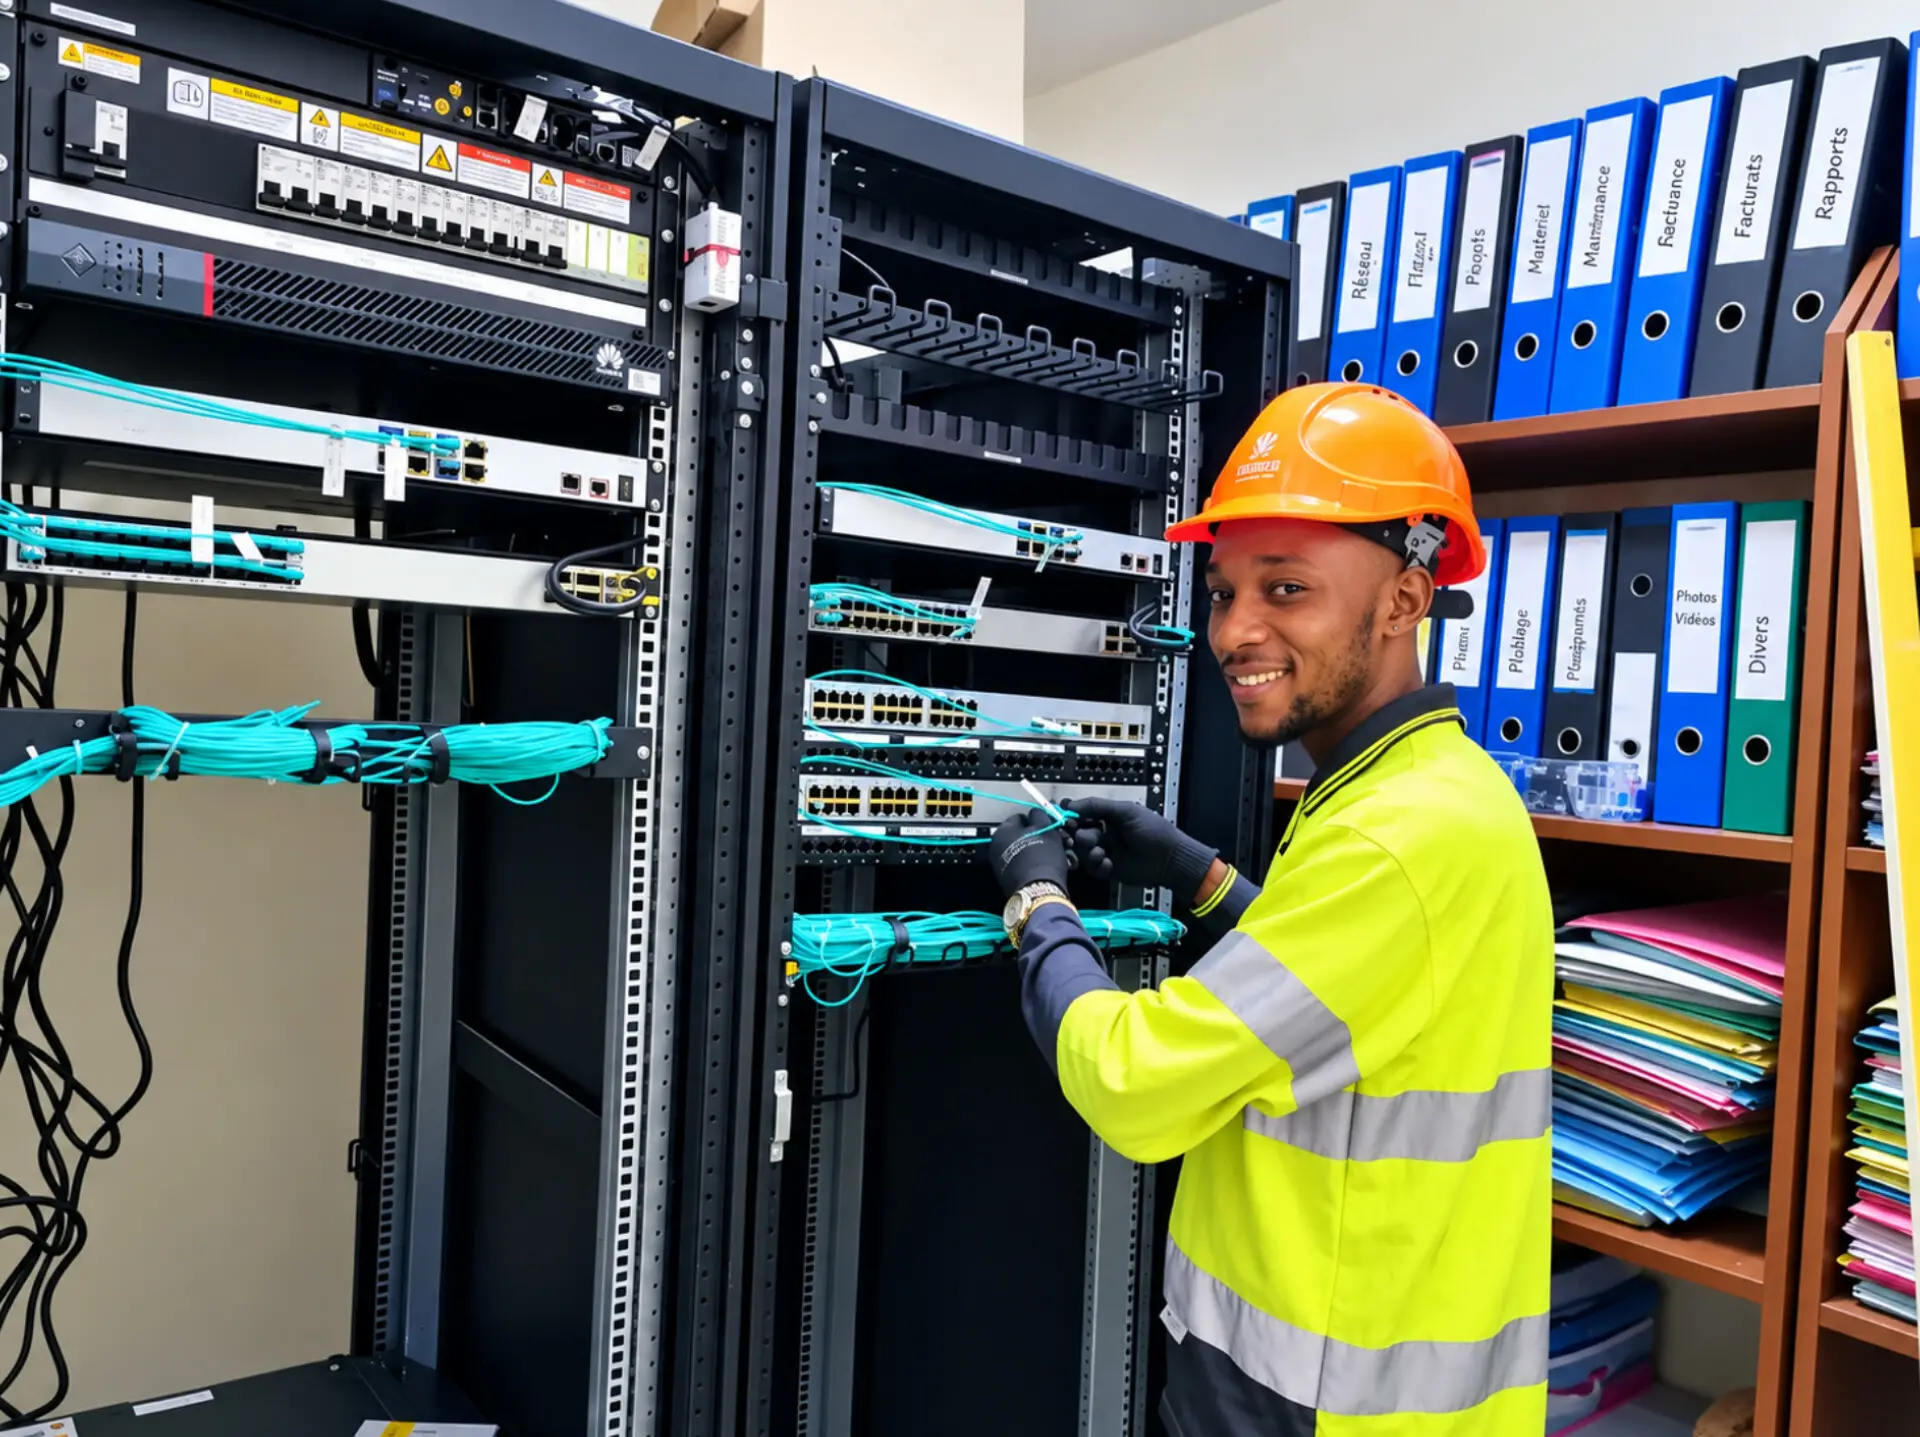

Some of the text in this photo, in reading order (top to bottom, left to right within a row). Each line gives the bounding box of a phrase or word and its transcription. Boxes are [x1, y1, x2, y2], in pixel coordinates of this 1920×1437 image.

[1733, 154, 1763, 238] Facturats
[1814, 127, 1849, 220] Rapports
[1676, 589, 1718, 604] Photos
[1748, 616, 1770, 674] Divers
